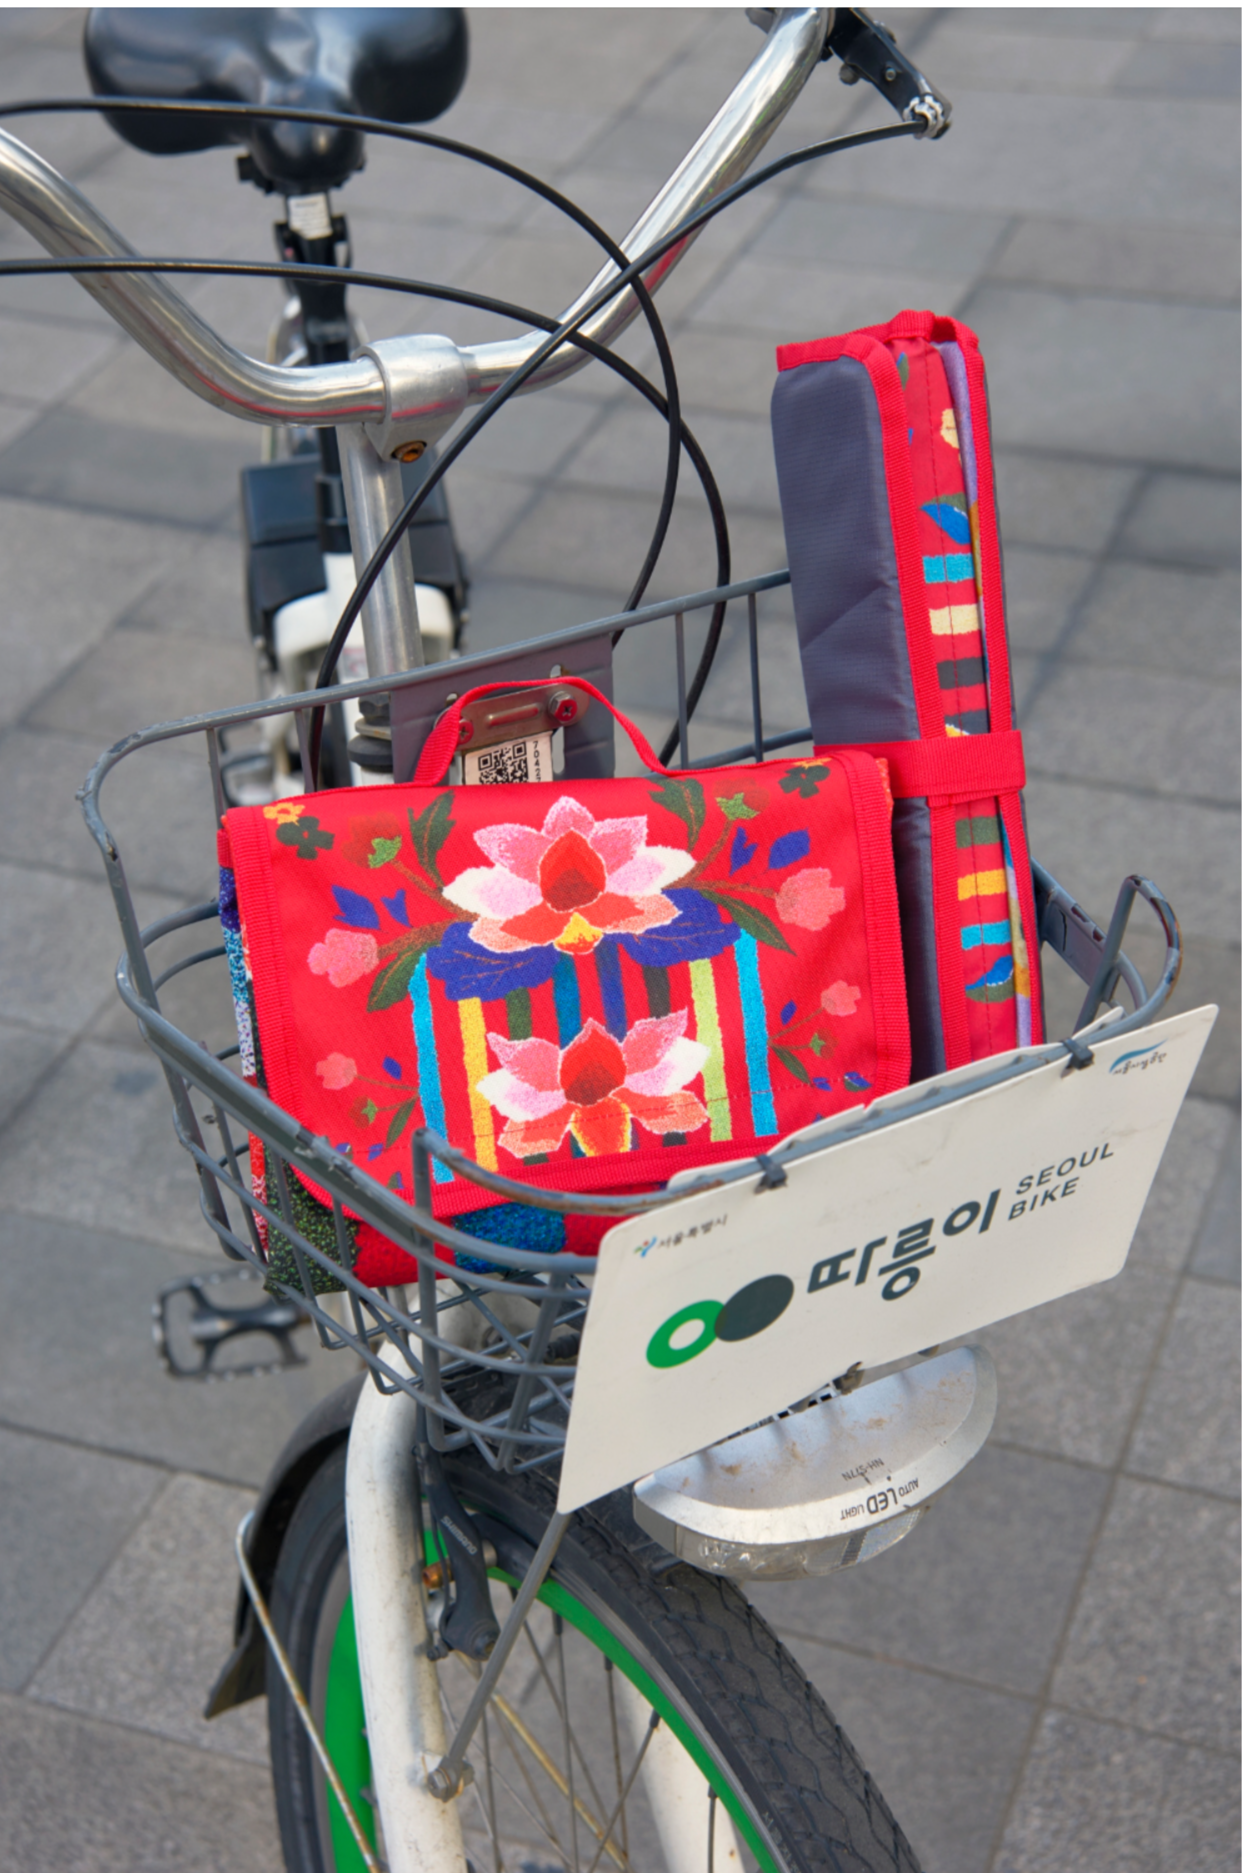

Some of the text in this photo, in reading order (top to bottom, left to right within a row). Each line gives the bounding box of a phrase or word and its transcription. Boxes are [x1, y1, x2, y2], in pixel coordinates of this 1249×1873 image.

[1015, 1143, 1114, 1195] SEOUL
[1007, 1177, 1080, 1221] BIKE
[807, 1188, 1001, 1301] 따릉이
[840, 1478, 919, 1521] AUTO LED LIGHT
